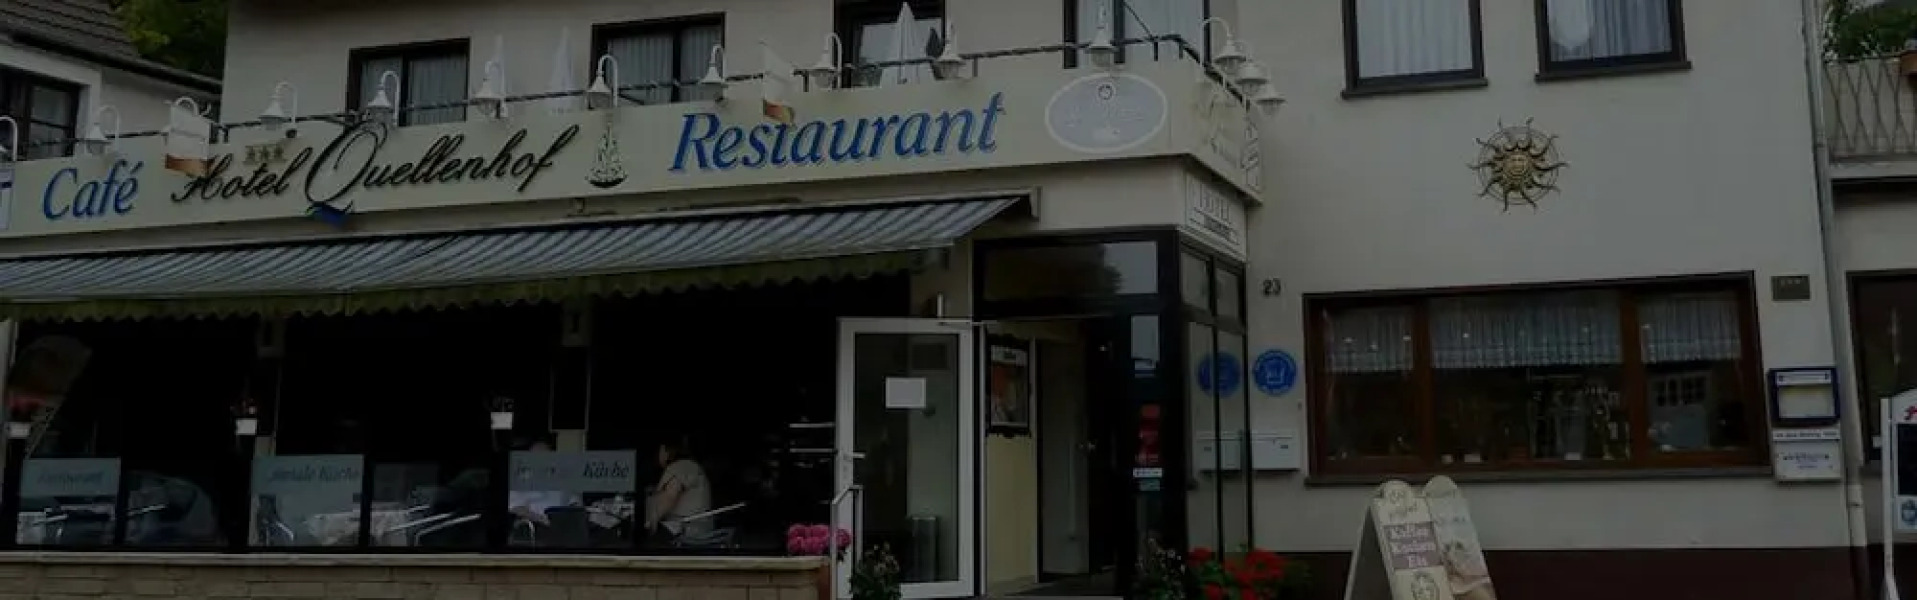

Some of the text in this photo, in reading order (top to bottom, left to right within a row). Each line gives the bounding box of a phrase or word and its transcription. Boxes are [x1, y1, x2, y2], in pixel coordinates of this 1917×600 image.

[171, 120, 580, 211] Hotel Quellenhof
[668, 91, 1006, 172] Restaurant
[42, 158, 145, 220] Café
[1262, 278, 1282, 297] 23
